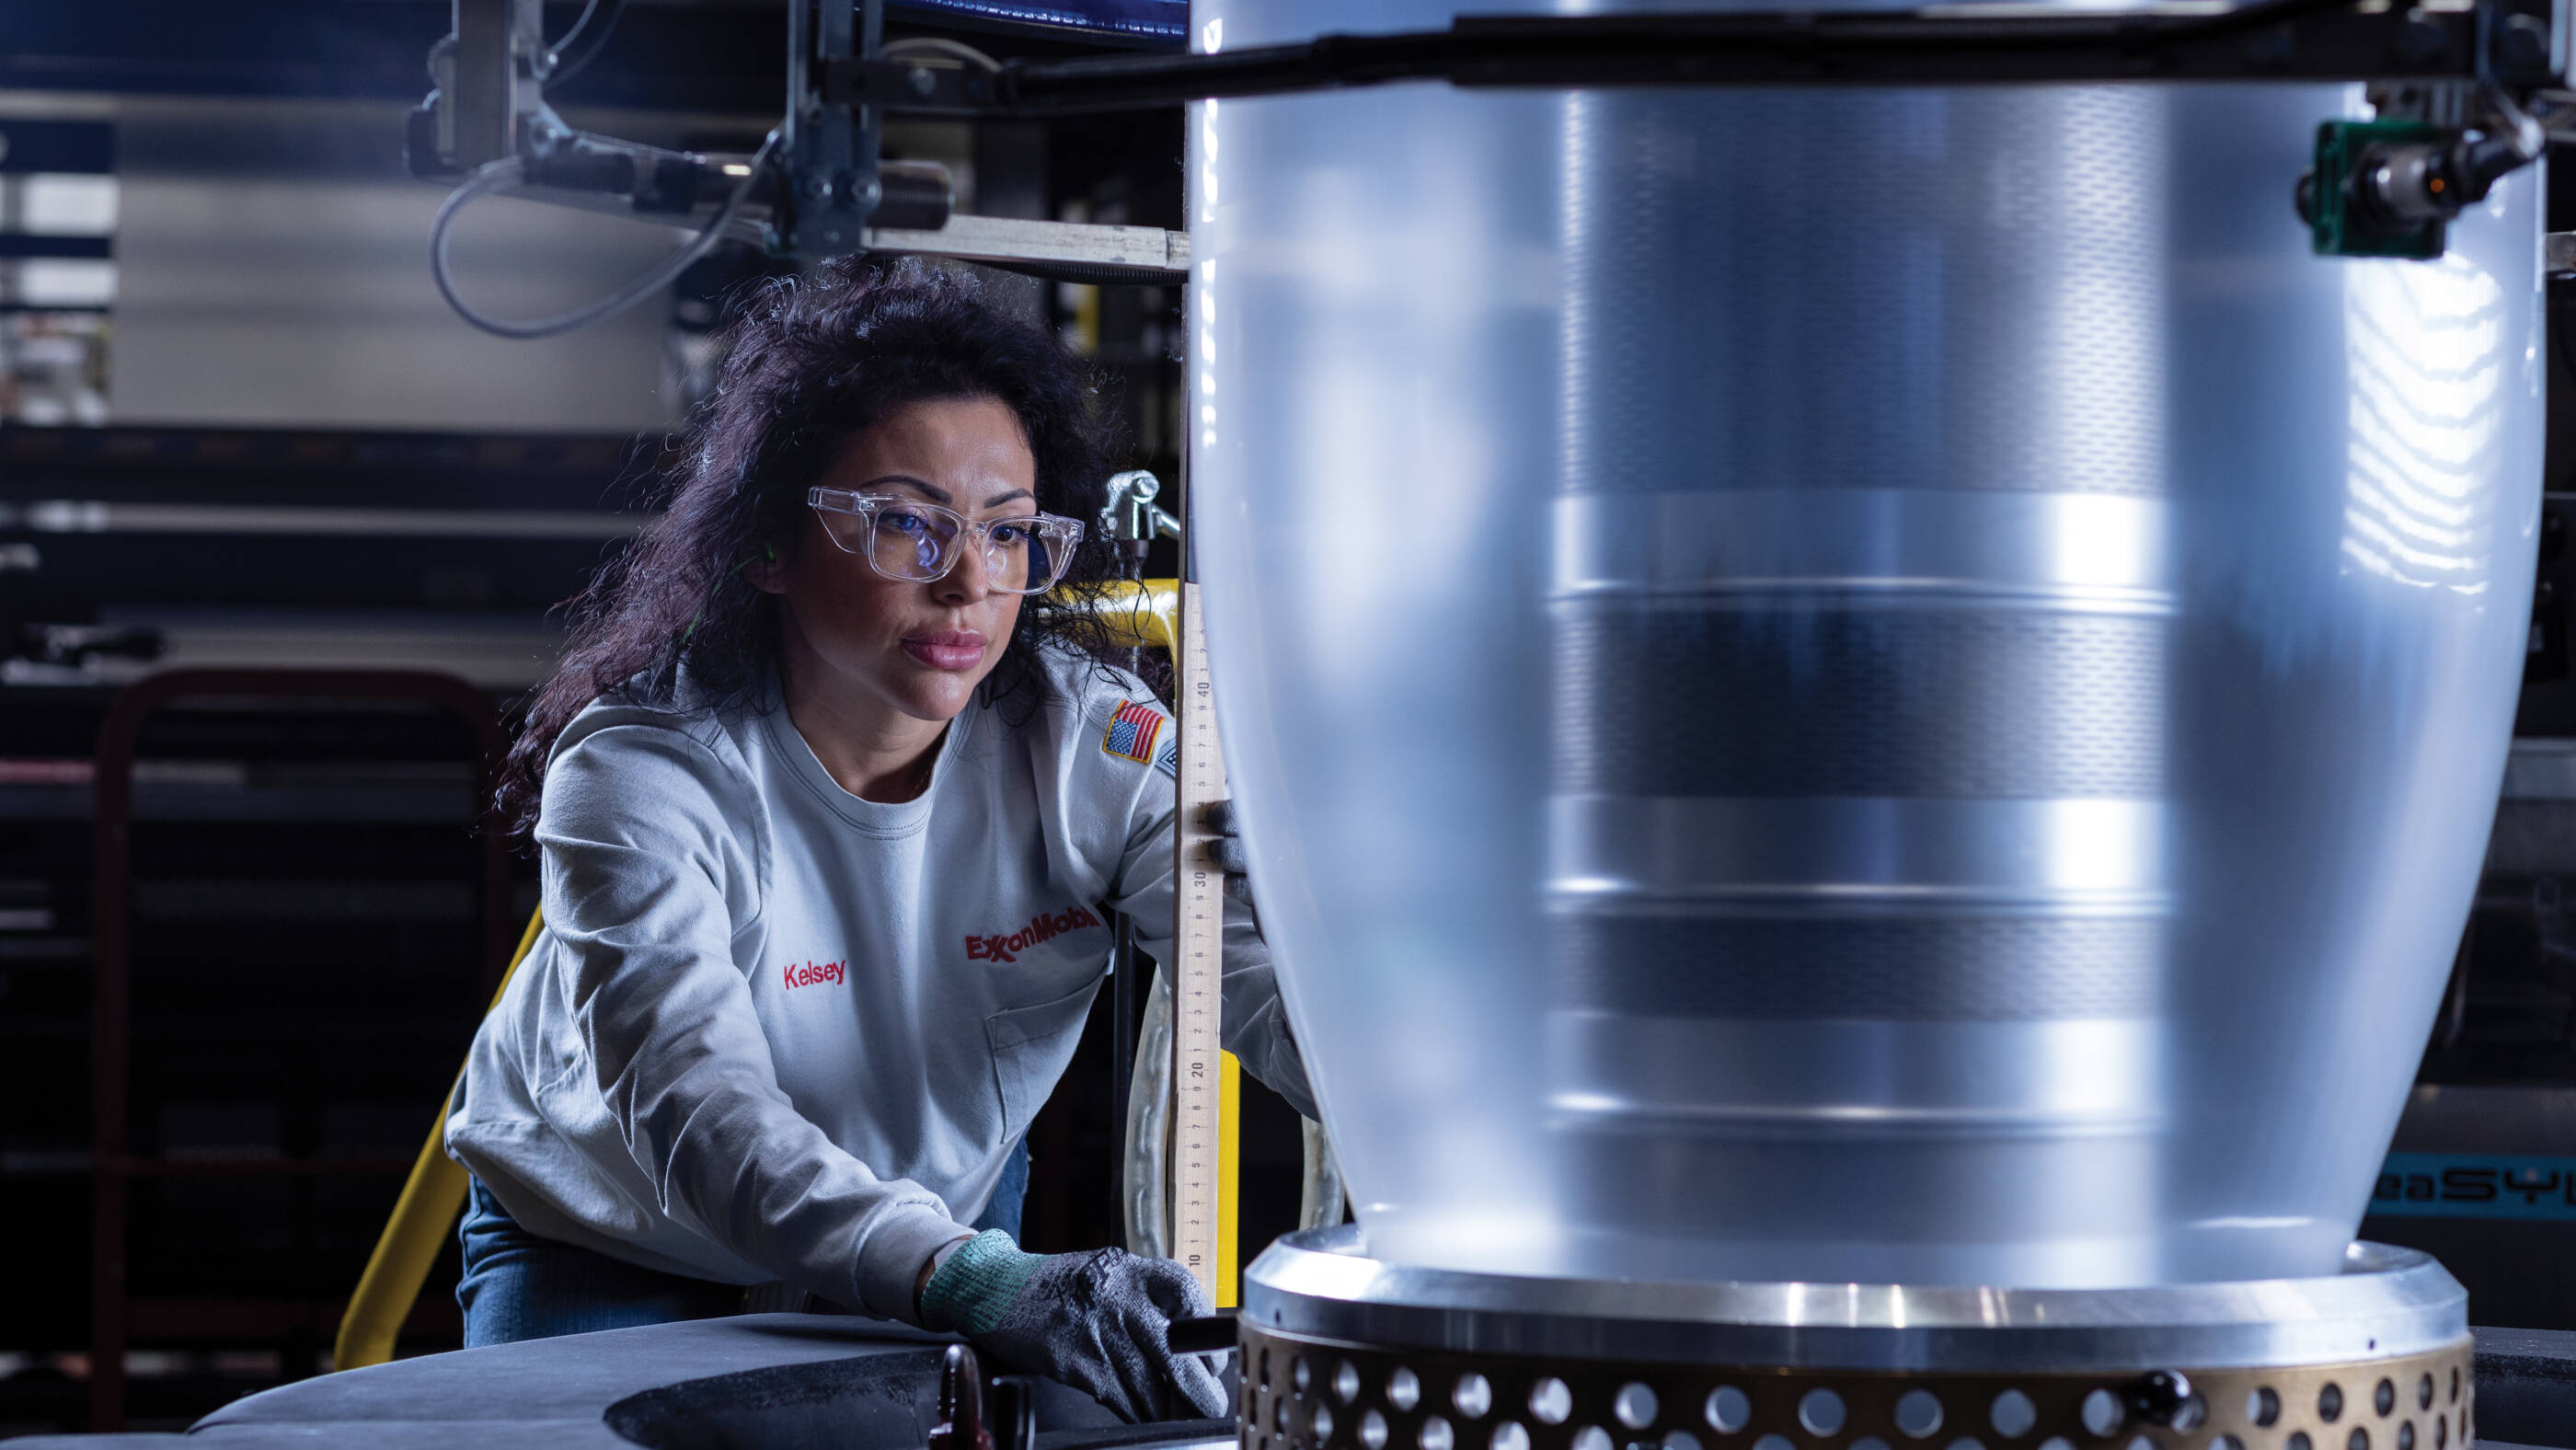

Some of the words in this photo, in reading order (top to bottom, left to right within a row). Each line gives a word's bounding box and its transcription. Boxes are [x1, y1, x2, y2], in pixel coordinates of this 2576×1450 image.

[1197, 682, 1210, 697] 40
[1194, 871, 1206, 887] 30
[784, 960, 845, 990] Kelsey
[1191, 1063, 1203, 1077] 20
[1189, 1254, 1201, 1267] 10
